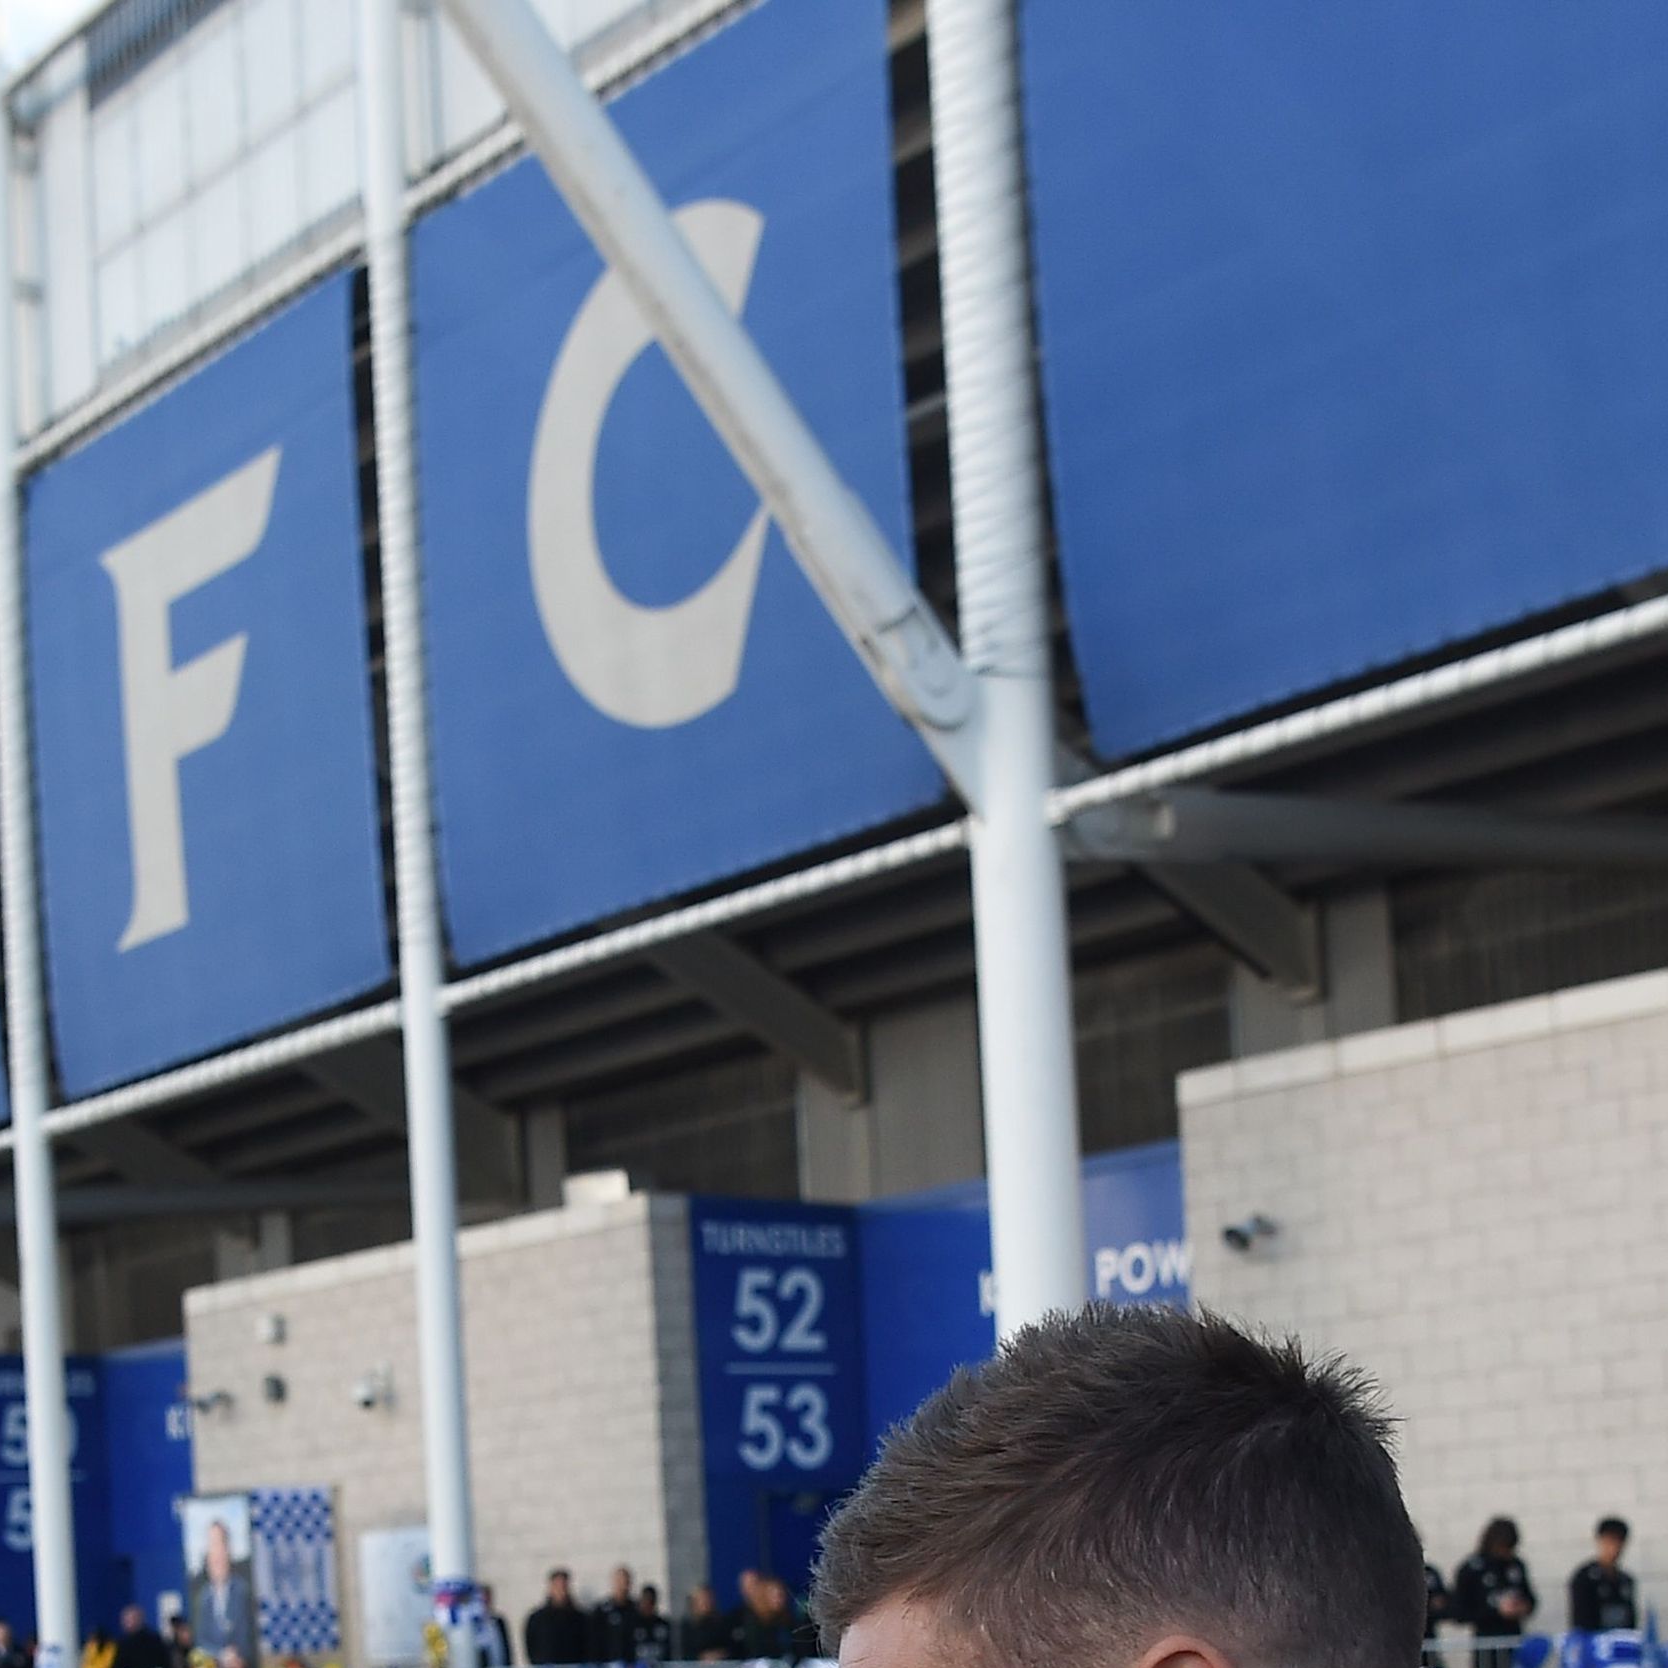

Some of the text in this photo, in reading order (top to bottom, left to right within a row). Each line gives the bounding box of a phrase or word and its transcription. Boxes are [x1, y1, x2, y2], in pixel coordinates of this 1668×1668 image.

[702, 1220, 846, 1258] TURNSTILES
[732, 1269, 828, 1353] 52
[738, 1384, 833, 1470] 53
